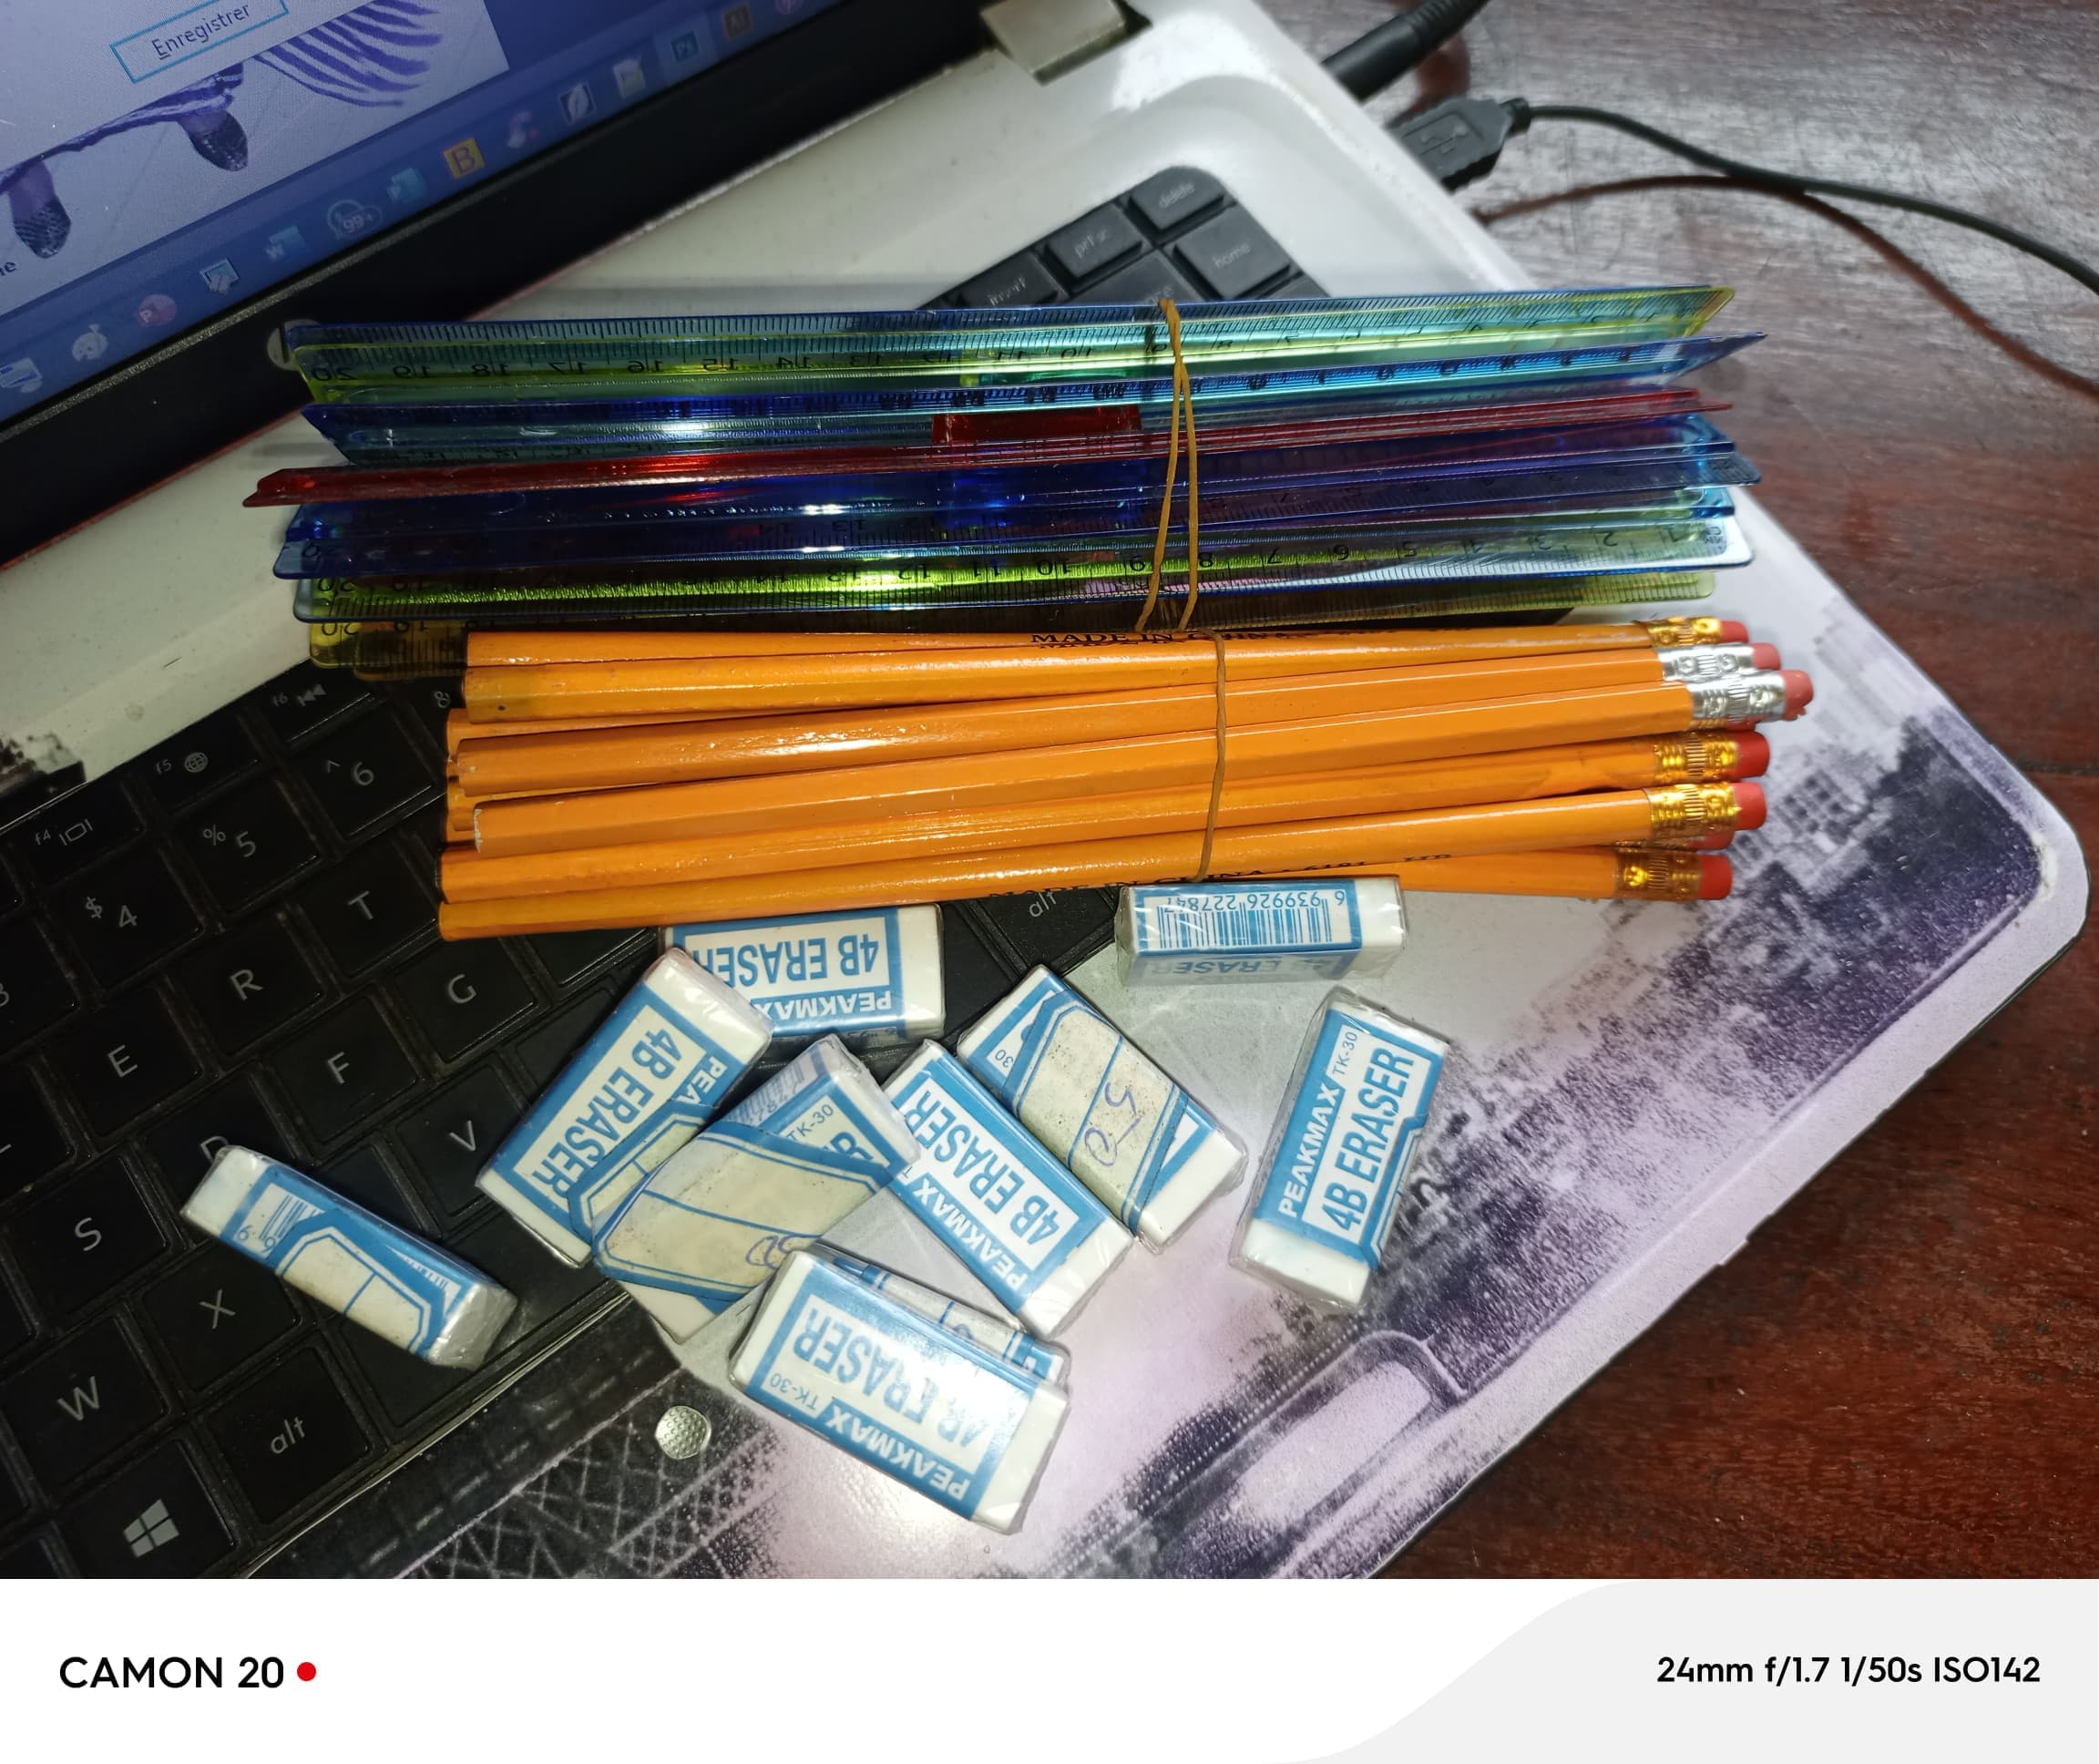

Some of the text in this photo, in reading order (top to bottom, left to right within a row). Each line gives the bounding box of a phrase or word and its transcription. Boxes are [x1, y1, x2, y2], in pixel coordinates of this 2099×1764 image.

[152, 5, 250, 59] Enregistrer
[1213, 242, 1251, 268] home
[1334, 544, 1349, 560] 6
[1403, 541, 1418, 557] 5
[1602, 531, 1618, 547] 2
[898, 563, 931, 579] 12
[1037, 559, 1071, 575] 10
[1130, 555, 1145, 572] 9
[1198, 551, 1213, 568] 8
[1267, 549, 1283, 565] 7
[1031, 632, 1130, 643] MADE
[1131, 632, 1174, 643] IN
[353, 762, 374, 786] 6
[35, 830, 51, 846] f4
[203, 824, 226, 846] %
[236, 831, 257, 857] 5
[85, 895, 103, 919] $
[349, 891, 374, 921] T
[1029, 891, 1058, 918] alt
[1163, 890, 1346, 912] 6 939926 227847
[118, 906, 138, 929] 4
[838, 932, 880, 975] 4B
[230, 969, 262, 1000] R
[447, 973, 477, 1004] G
[108, 1043, 138, 1077] E
[327, 1051, 353, 1085] F
[631, 1028, 684, 1081] 4B
[1332, 1031, 1358, 1077] TK-30
[449, 1119, 477, 1153] V
[532, 1066, 654, 1199] ERASER
[787, 1103, 834, 1141] TK-30
[1277, 1080, 1344, 1219] PEAKMAX
[1322, 1048, 1415, 1232] 4B ERASER
[905, 1091, 1060, 1245] 4B ERASER
[74, 1216, 103, 1251] S
[912, 1177, 1029, 1292] PEAKMAX
[200, 1288, 236, 1329] X
[792, 1308, 940, 1425] ERASER
[57, 1375, 101, 1421] W
[269, 1414, 306, 1455] alt
[769, 1372, 971, 1502] PEAKMAX TK-30
